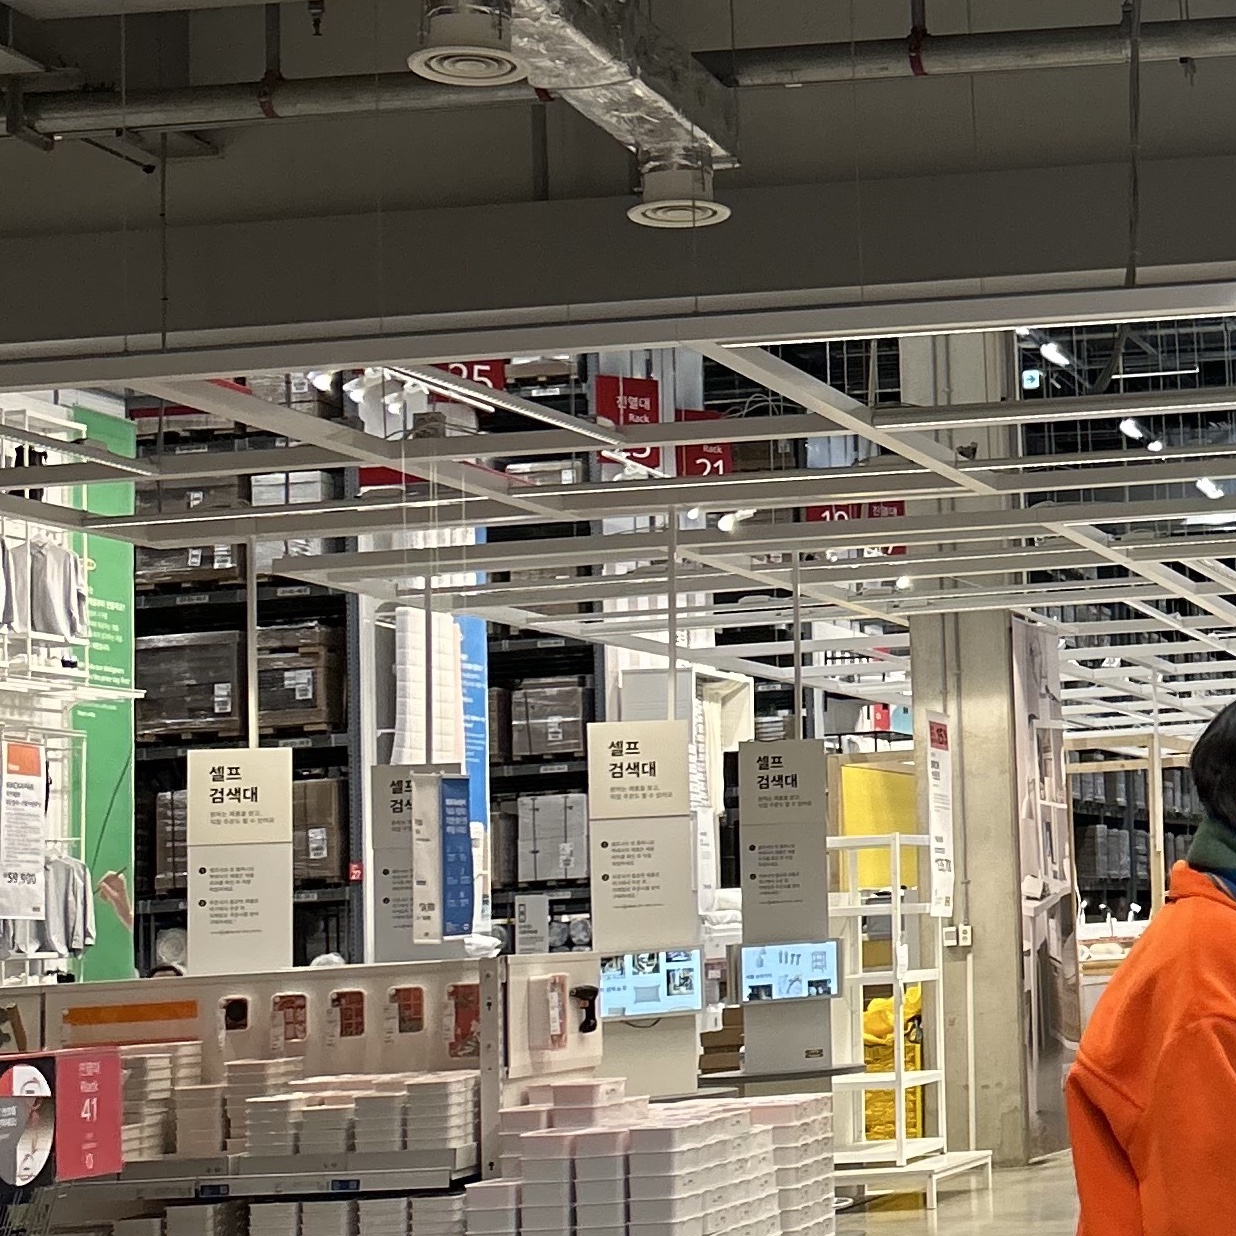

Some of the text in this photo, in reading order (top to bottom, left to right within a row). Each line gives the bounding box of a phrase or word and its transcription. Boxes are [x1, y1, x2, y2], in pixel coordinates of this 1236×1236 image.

[616, 395, 651, 411] 진열대
[628, 412, 650, 424] Rack
[703, 444, 722, 454] Rack
[696, 458, 724, 476] 21
[609, 740, 640, 757] 셀프
[608, 761, 656, 779] 검색대
[756, 755, 784, 770] 셀프
[209, 766, 242, 782] 셀프
[757, 774, 798, 790] 검색대
[209, 786, 258, 804] 검색대
[80, 1097, 98, 1122] 41
